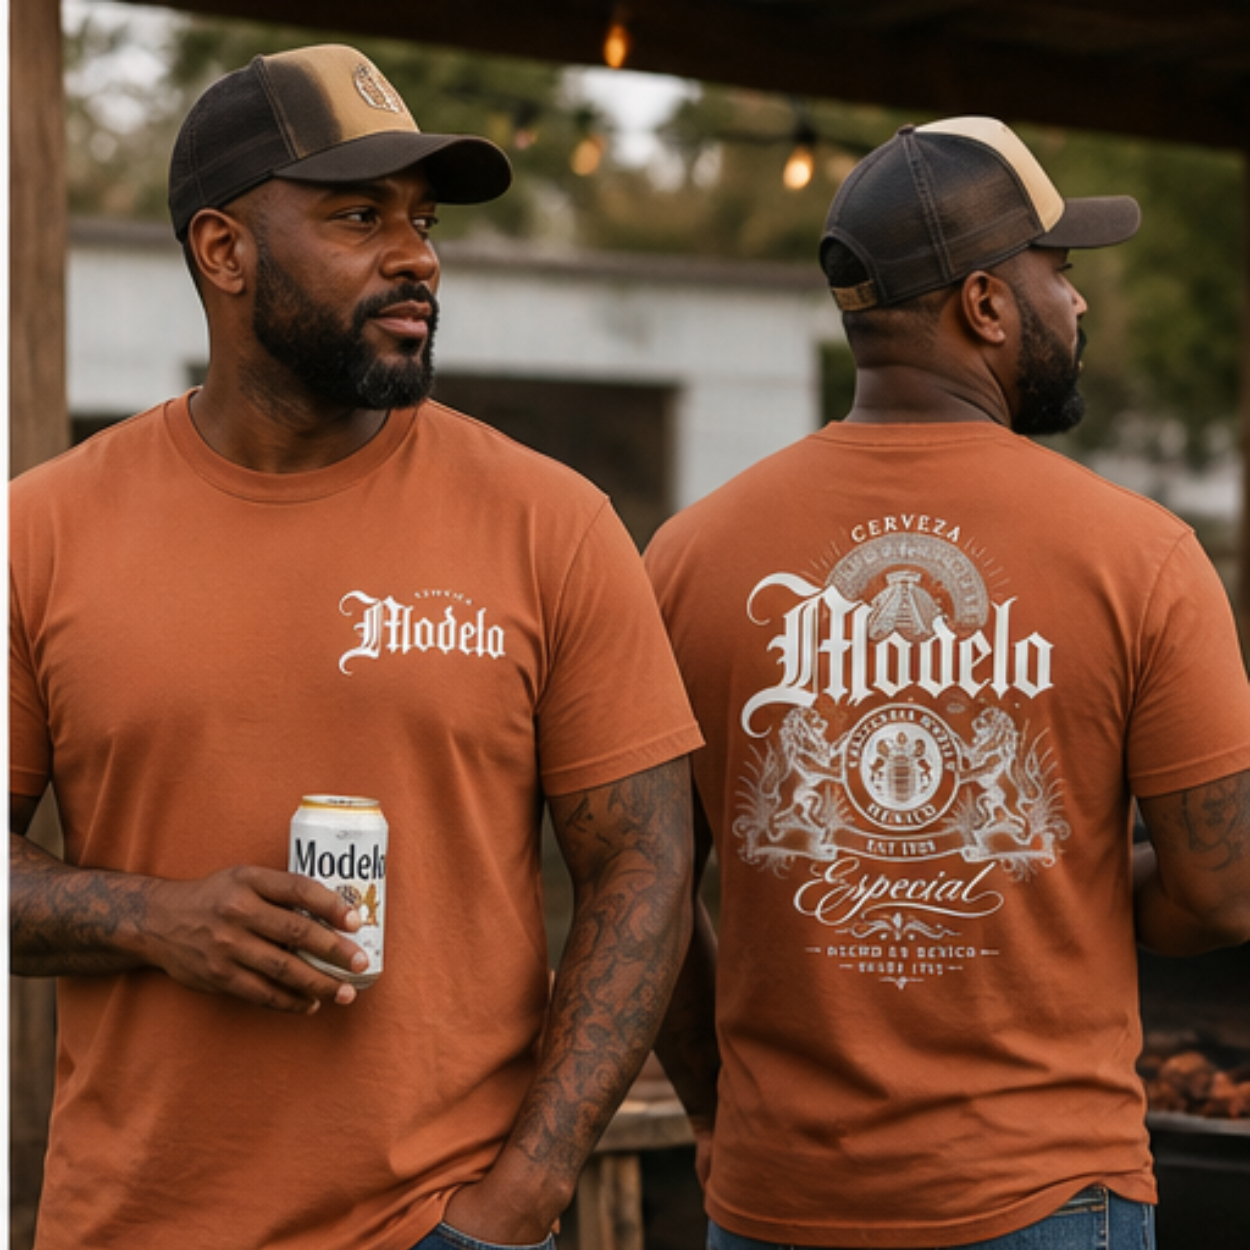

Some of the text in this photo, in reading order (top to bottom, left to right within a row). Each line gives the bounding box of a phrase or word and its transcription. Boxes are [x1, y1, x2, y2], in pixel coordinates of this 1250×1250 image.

[851, 514, 961, 543] CERVEZA
[741, 572, 1054, 738] Modelo
[794, 857, 1003, 925] Especial
